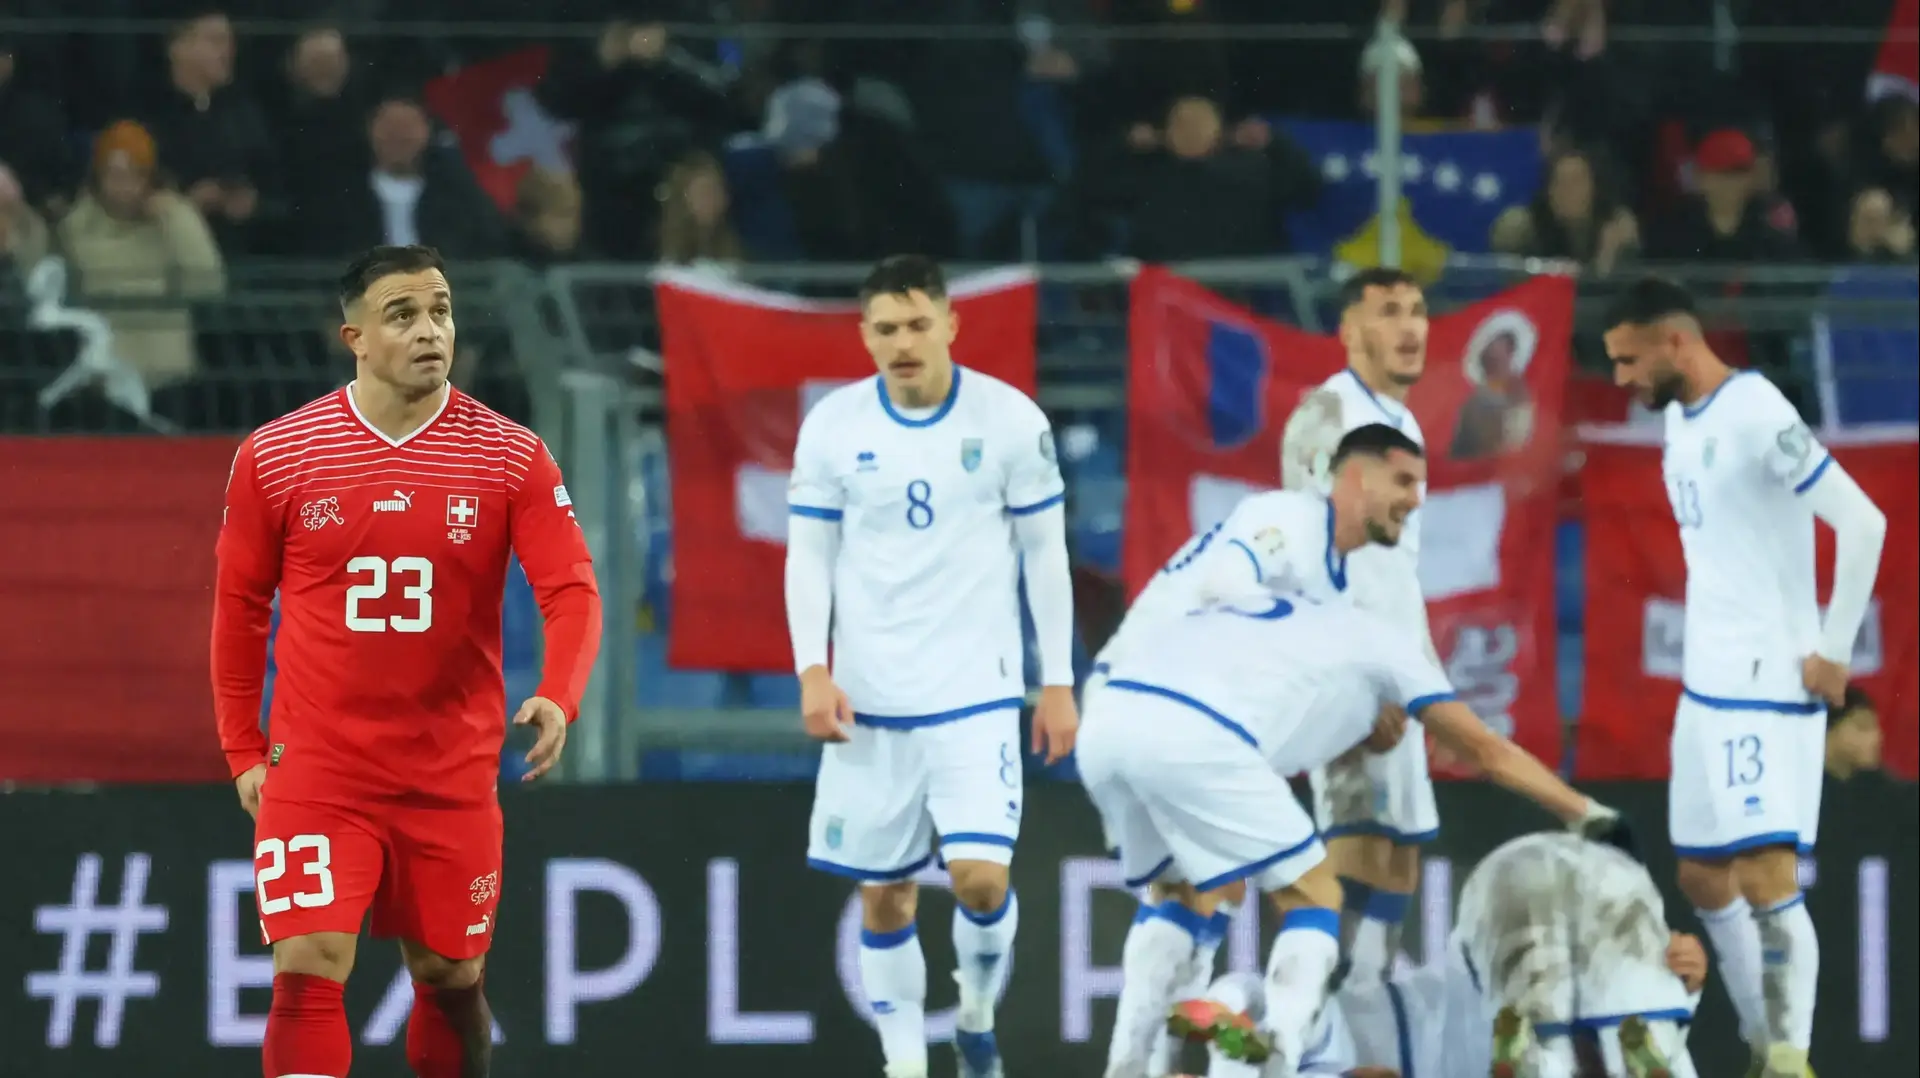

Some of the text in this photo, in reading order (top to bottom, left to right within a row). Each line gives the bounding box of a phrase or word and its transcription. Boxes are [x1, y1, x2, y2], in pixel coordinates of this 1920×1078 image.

[373, 500, 406, 512] PUMA
[906, 479, 934, 529] 8
[346, 556, 433, 632] 23
[1722, 735, 1764, 789] 13
[256, 834, 335, 915] 23
